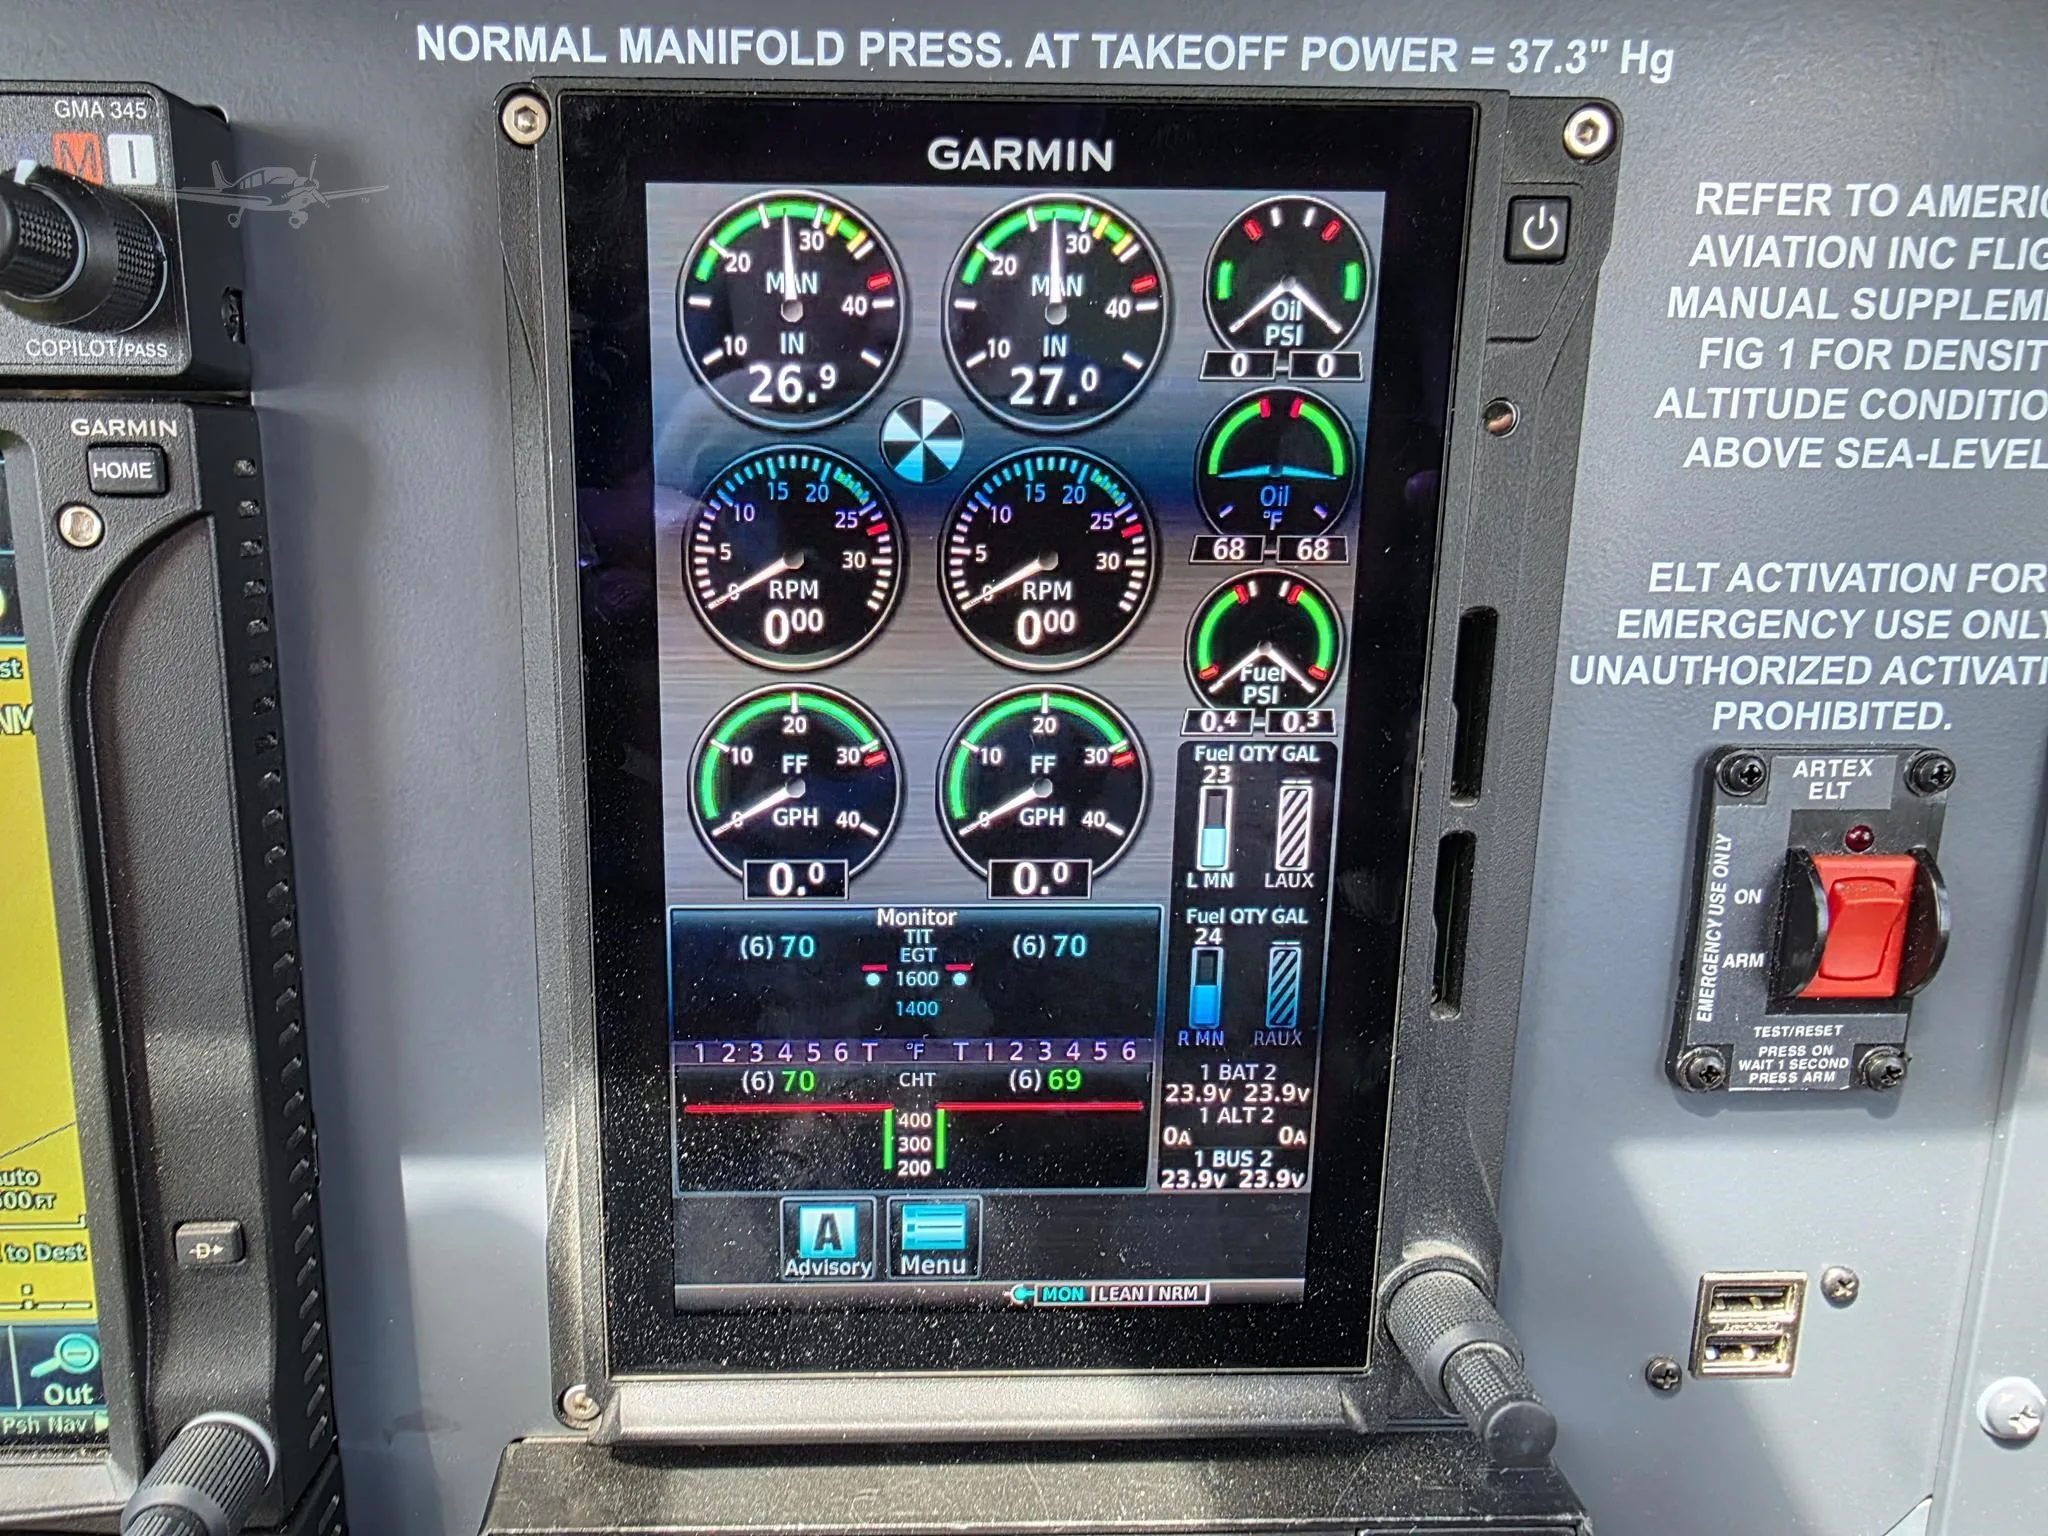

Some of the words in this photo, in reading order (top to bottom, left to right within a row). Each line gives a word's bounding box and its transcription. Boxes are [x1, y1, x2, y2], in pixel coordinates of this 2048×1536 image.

[417, 25, 606, 63] NORMAL
[619, 27, 844, 67] MANIFOLD
[860, 31, 1013, 68] PRESS.
[1025, 33, 1079, 69] AT
[1092, 33, 1287, 71] TAKEOFF
[1301, 36, 1457, 73] POWER
[1471, 46, 1495, 66] =
[1507, 38, 1608, 75] 37.3"
[1620, 40, 1674, 84] Hg
[54, 100, 104, 118] GMA
[110, 102, 147, 120] 345
[927, 138, 1113, 172] GARMIN
[1696, 182, 1832, 216] REFER
[1845, 183, 1898, 218] TO
[799, 231, 825, 251] 30
[1688, 235, 1877, 268] AVIATION
[1887, 236, 1957, 270] INC
[724, 252, 751, 273] 20
[841, 296, 867, 316] 40
[1271, 300, 1303, 321] Oil
[1667, 286, 1840, 320] MANUAL
[1851, 288, 2048, 321] SUPPLEM
[780, 332, 805, 355] IN
[1265, 326, 1304, 346] PSI
[26, 336, 169, 360] COPILOT/PASS
[724, 336, 748, 356] 10
[1043, 335, 1067, 357] IN
[1700, 337, 1764, 370] FIG
[1778, 338, 1795, 370] 1
[1809, 338, 1893, 371] FOR
[1904, 339, 2048, 371] DENSIT
[1231, 353, 1248, 377] 0
[1317, 353, 1334, 377] 0
[749, 364, 837, 404] 26.9
[1010, 366, 1098, 406] 27.0
[1654, 387, 1849, 419] ALTITUDE
[1860, 388, 2048, 421] CONDITIO
[71, 418, 177, 438] GARMIN
[1683, 436, 1825, 469] ABOVE
[1835, 437, 2048, 470] SEA-LEVEL
[93, 461, 153, 479] HOME
[767, 482, 789, 500] 15
[805, 484, 829, 502] 20
[1260, 485, 1290, 507] Oil
[733, 503, 756, 522] 10
[835, 511, 858, 529] 25
[720, 544, 732, 561] 5
[1213, 538, 1245, 560] 68
[1297, 538, 1329, 561] 68
[842, 552, 866, 569] 30
[1648, 562, 1720, 592] ELT
[1726, 562, 1957, 593] ACTIVATION
[1967, 563, 2047, 593] FOR
[769, 580, 819, 600] RPM
[1022, 581, 1072, 600] RPM
[1617, 609, 1865, 640] EMERGENCY
[1874, 609, 1953, 639] USE
[1240, 665, 1287, 682] Fuel
[1569, 655, 1873, 686] UNAUTHORIZED
[1880, 655, 2048, 686] ACTIVATI
[1243, 686, 1280, 705] PSI
[782, 717, 807, 733] 20
[1200, 711, 1237, 732] 0.4
[1282, 711, 1319, 732] 0.3
[1712, 701, 1952, 731] PROHIBITED.
[731, 748, 753, 764] 10
[836, 748, 860, 765] 30
[1194, 745, 1233, 762] Fuel
[1282, 746, 1320, 762] GAL
[782, 755, 808, 774] FF
[1030, 755, 1056, 774] FF
[1792, 759, 1874, 779] ARTEX
[1203, 765, 1231, 784] 23
[1808, 782, 1852, 801] ELT
[773, 808, 819, 827] GPH
[836, 812, 860, 828] 40
[1020, 808, 1065, 826] GPH
[1712, 833, 1733, 878] ONLY
[769, 862, 825, 896] 0.0
[1013, 861, 1069, 895] 0.0
[1204, 873, 1234, 888] MN
[1707, 881, 1728, 916] USE
[1734, 889, 1763, 905] ON
[877, 908, 957, 926] Monitor
[1186, 908, 1225, 924] Fuel
[1271, 908, 1308, 924] GAL
[904, 929, 933, 944] TIT
[1195, 928, 1223, 945] 24
[900, 947, 938, 962] EGT
[1722, 953, 1765, 969] ARM
[896, 971, 939, 987] 1600
[1696, 918, 1723, 1023] EMERGENCY
[895, 1001, 939, 1016] 1400
[1753, 1024, 1844, 1039] TEST/RESET
[1758, 1045, 1806, 1057] PRESS
[1811, 1044, 1833, 1057] ON
[1201, 1064, 1208, 1080] 1
[1219, 1064, 1258, 1080] BAT
[1264, 1064, 1276, 1080] 2
[1738, 1057, 1775, 1071] WAIT
[1778, 1057, 1785, 1070] 1
[1789, 1057, 1849, 1070] SECOND
[899, 1072, 937, 1087] CHT
[1748, 1071, 1799, 1085] PRESS
[1802, 1070, 1836, 1084] ARM
[899, 1112, 931, 1128] 400
[1200, 1107, 1207, 1123] 1
[1217, 1107, 1256, 1123] ALT
[1261, 1107, 1274, 1123] 2
[898, 1136, 931, 1152] 300
[898, 1160, 931, 1176] 200
[1194, 1151, 1202, 1167] 1
[1212, 1151, 1252, 1167] BUS
[1260, 1151, 1273, 1167] 2
[6, 1245, 29, 1261] to
[35, 1243, 86, 1261] Dest
[785, 1258, 872, 1279] Advisory
[901, 1255, 966, 1274] Menu
[1042, 1286, 1084, 1302] MON
[1100, 1286, 1144, 1300] LEAN
[1159, 1286, 1198, 1300] NRM
[44, 1383, 94, 1405] Out
[3, 1416, 40, 1435] Psh
[48, 1416, 87, 1434] Nav
